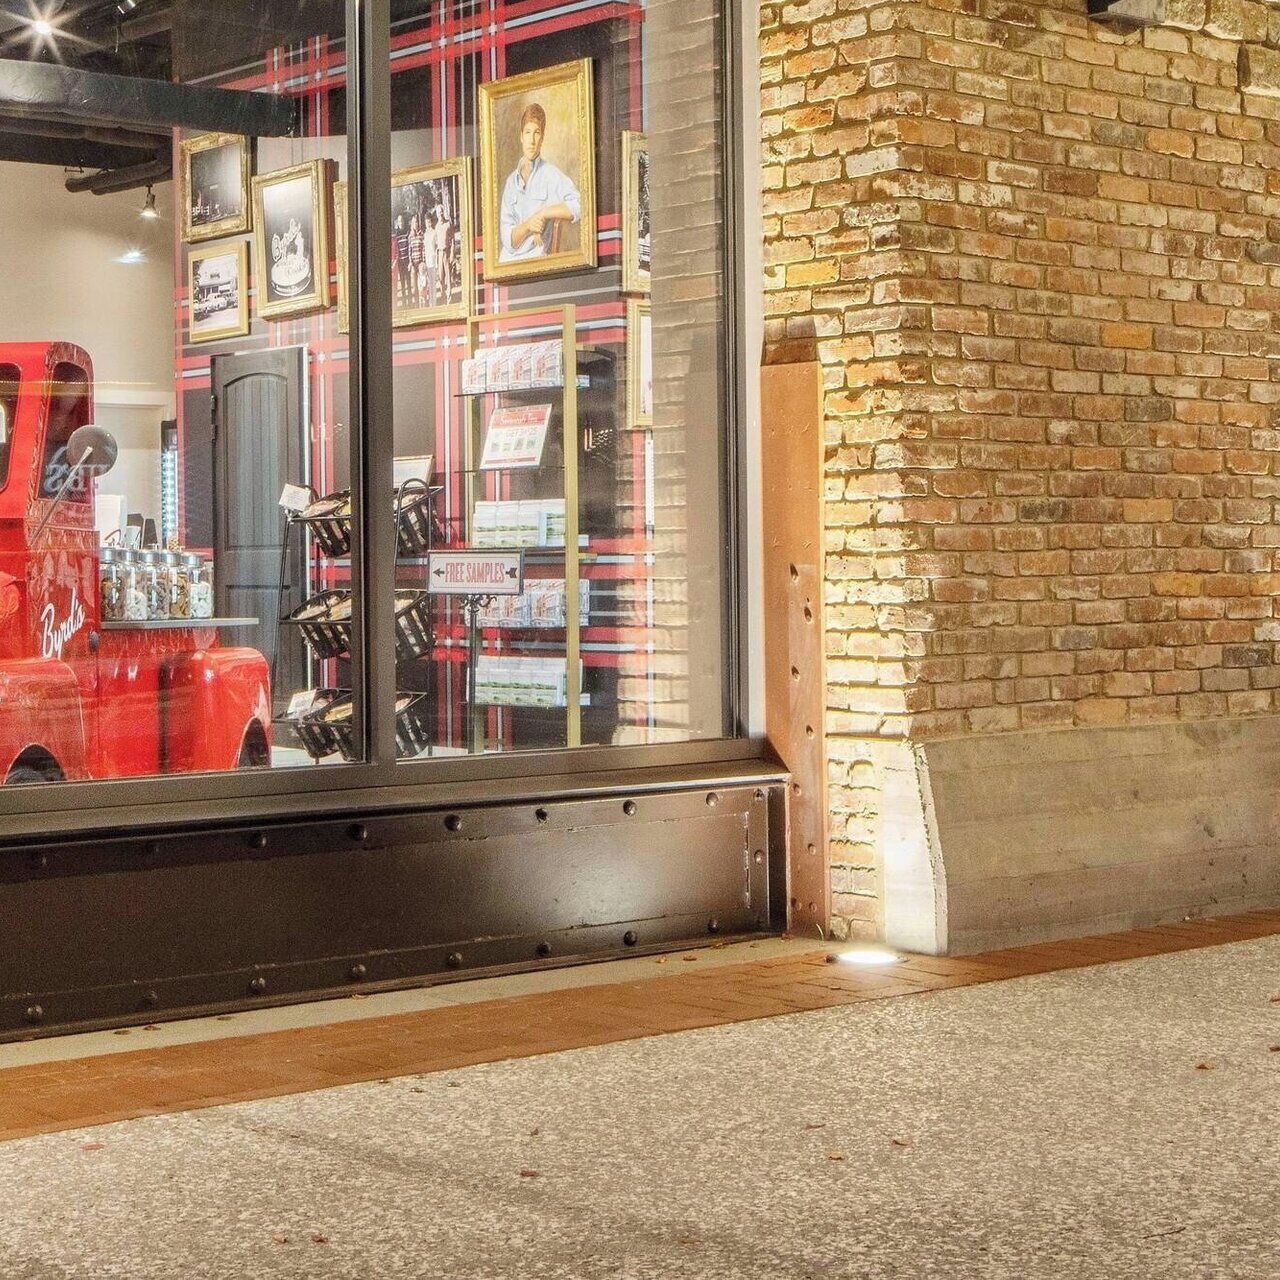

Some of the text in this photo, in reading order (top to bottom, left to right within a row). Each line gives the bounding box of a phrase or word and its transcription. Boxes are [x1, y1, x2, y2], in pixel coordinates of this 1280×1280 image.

[444, 562, 505, 584] FREE SAMPLES
[40, 587, 86, 661] Byrd's
